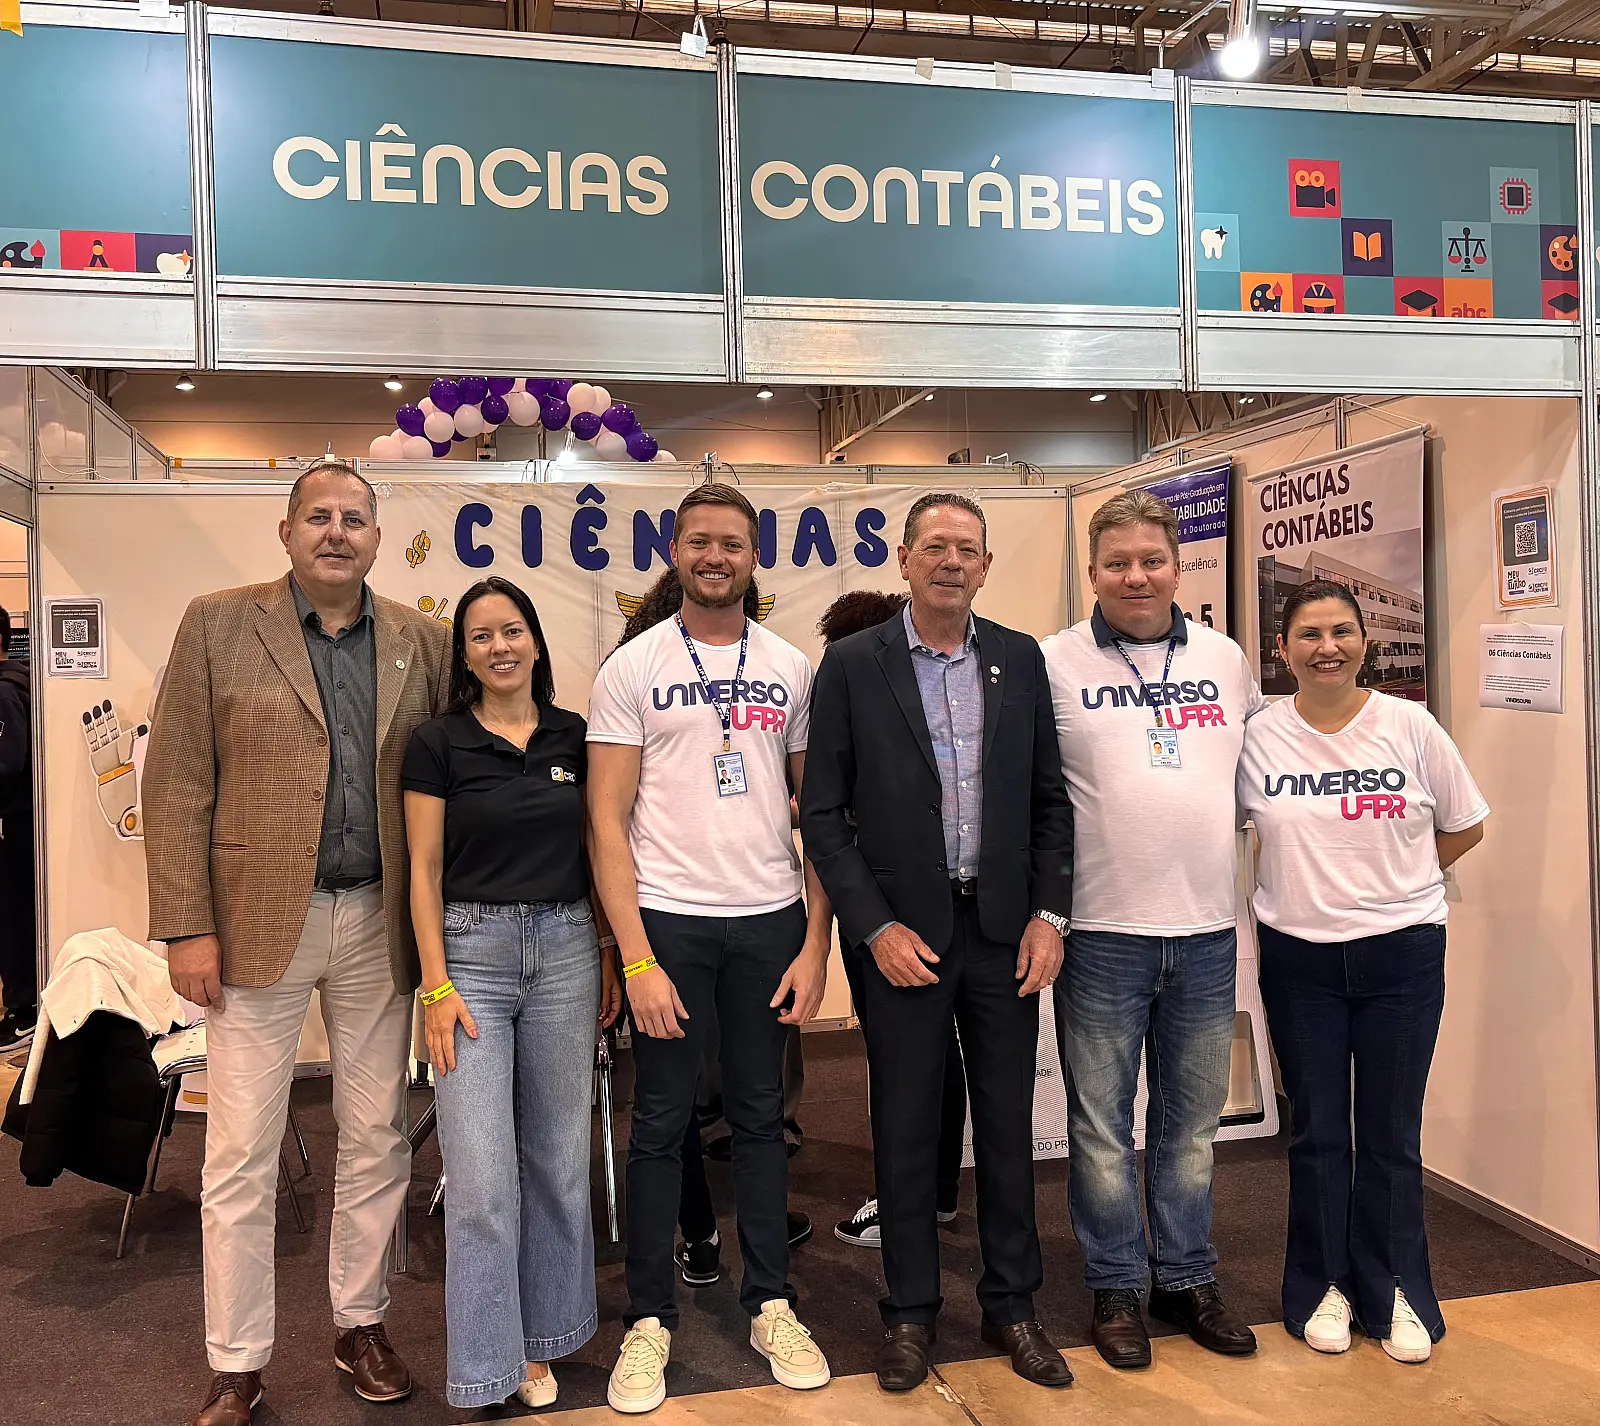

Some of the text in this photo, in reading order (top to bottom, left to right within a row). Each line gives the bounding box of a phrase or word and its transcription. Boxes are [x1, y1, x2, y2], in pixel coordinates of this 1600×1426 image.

[272, 123, 1165, 236] CIÊNCIAS CONTÁBEIS
[1451, 303, 1487, 318] abc
[1260, 463, 1350, 513] CIÊNCIAS
[1172, 496, 1226, 521] TABILIDADE
[454, 484, 888, 571] CIÊNIAS
[1189, 520, 1226, 534] Doutorado
[1262, 500, 1374, 551] CONTÁBEIS
[1181, 556, 1218, 573] Excelência
[1497, 649, 1522, 658] Ciências
[1522, 651, 1552, 660] Contábeis
[652, 679, 789, 711] UNIVERSO
[1081, 679, 1219, 710] UNIVERSO
[731, 705, 787, 735] UFPR
[1164, 704, 1228, 730] UFPR
[1264, 767, 1406, 797] UNIVERSO
[1341, 794, 1407, 820] UFPR
